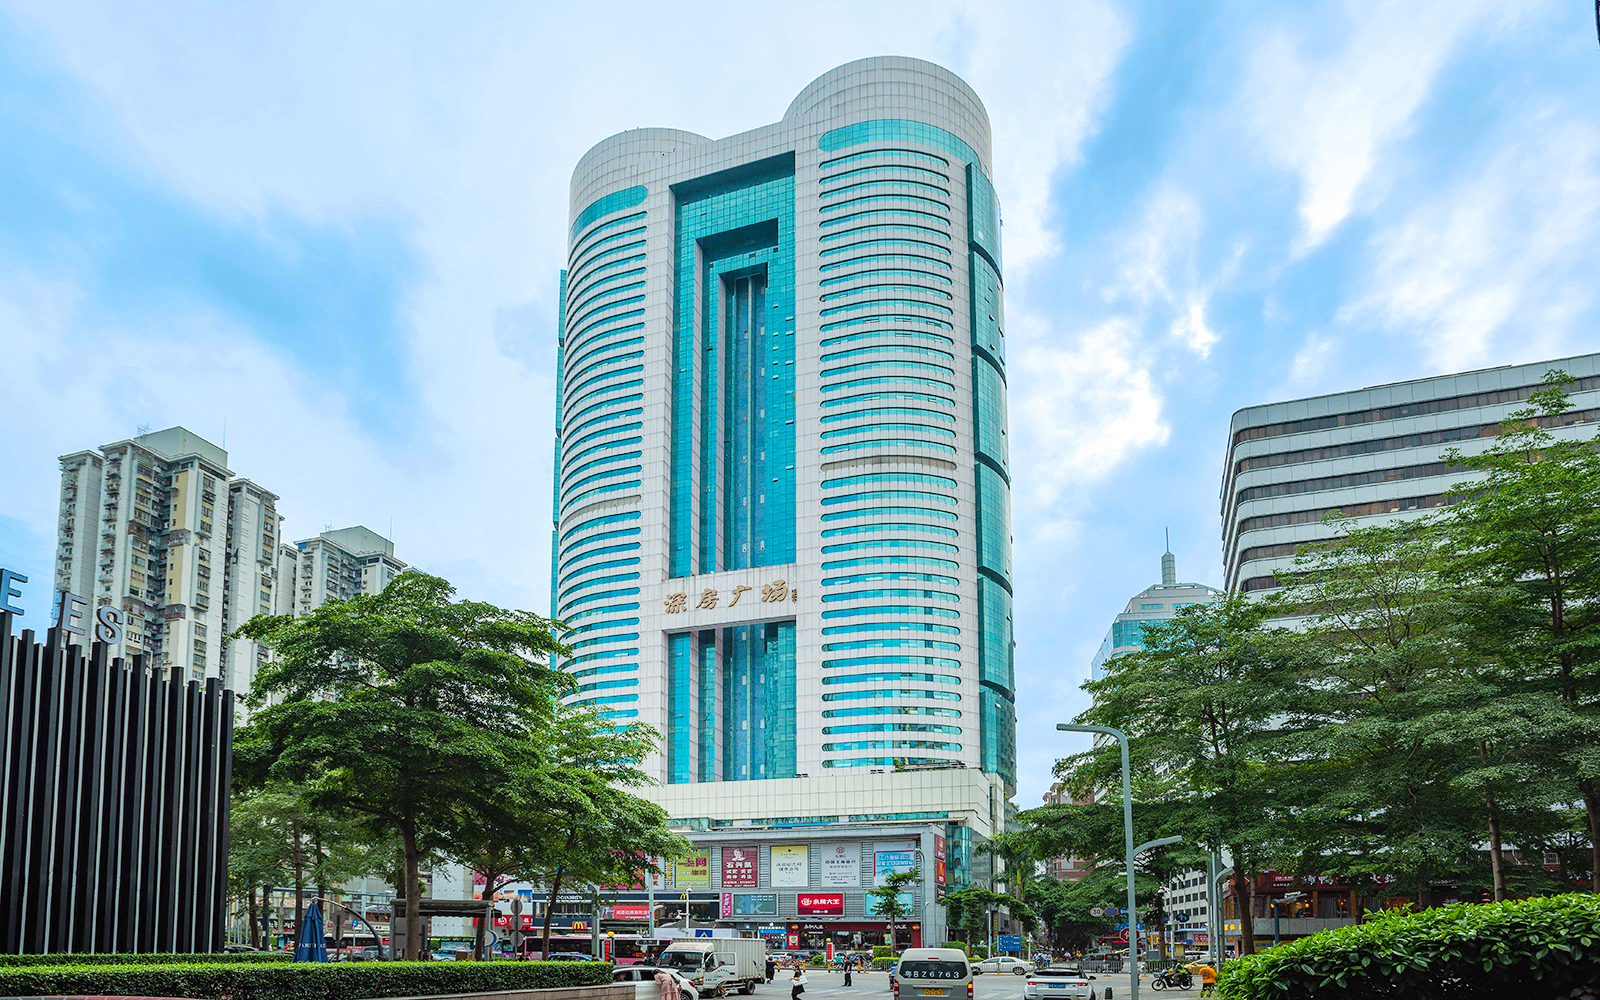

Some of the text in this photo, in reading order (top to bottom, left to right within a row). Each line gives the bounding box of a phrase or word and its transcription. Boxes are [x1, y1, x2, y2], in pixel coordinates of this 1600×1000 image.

[664, 579, 788, 614] 深房广场
[904, 970, 960, 979] 粤BZ6763
